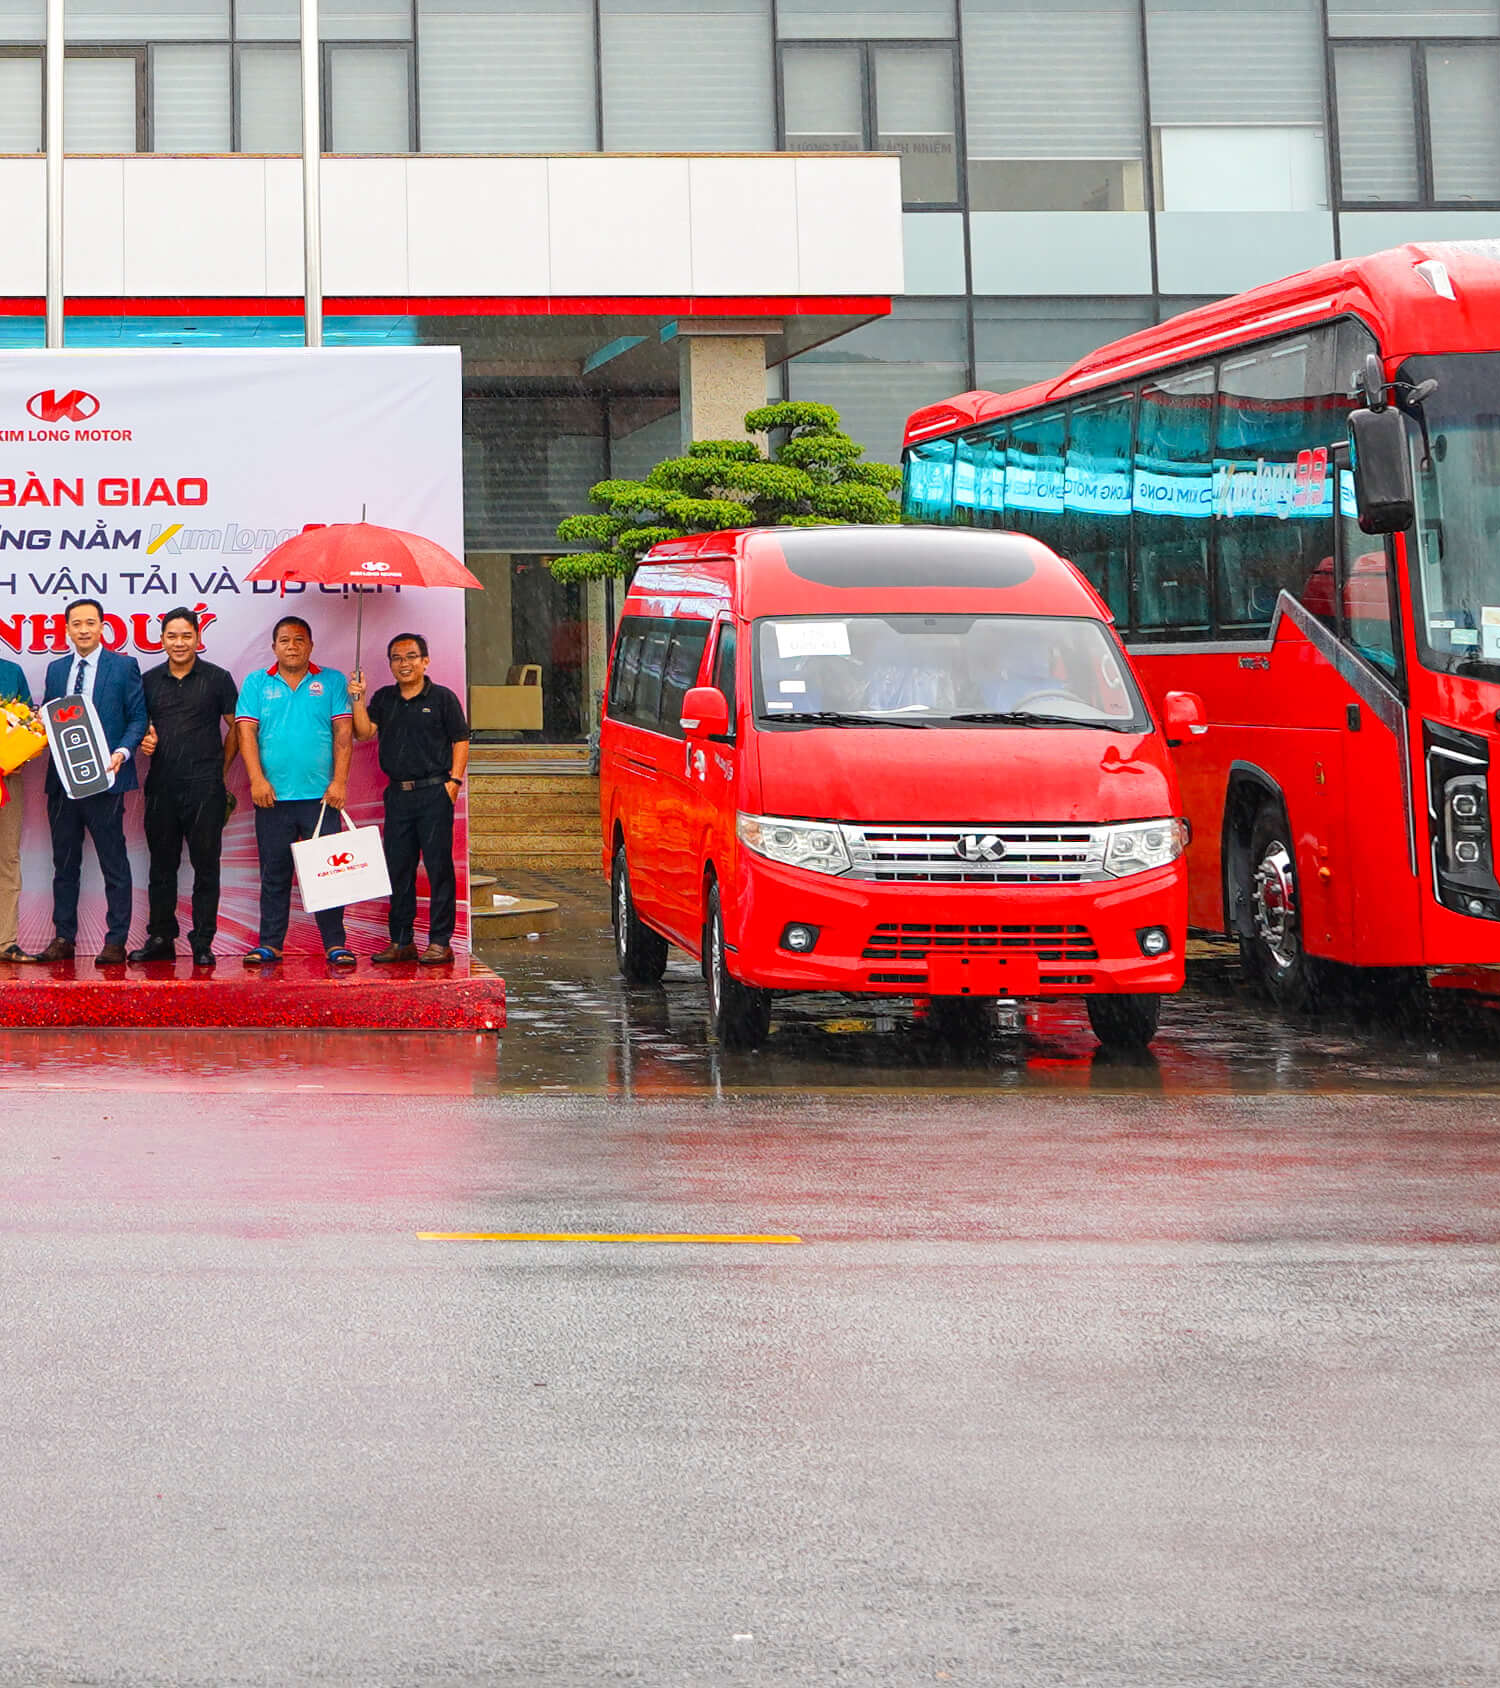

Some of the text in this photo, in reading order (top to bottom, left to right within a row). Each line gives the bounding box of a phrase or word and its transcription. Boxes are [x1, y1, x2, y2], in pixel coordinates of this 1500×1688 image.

[28, 430, 70, 442] LONG
[74, 430, 132, 442] MOTOR
[97, 477, 209, 507] GIAO
[59, 520, 142, 550] NẰM
[28, 566, 107, 601] VẬN
[120, 565, 177, 595] TẢI
[189, 566, 241, 595] VÀ
